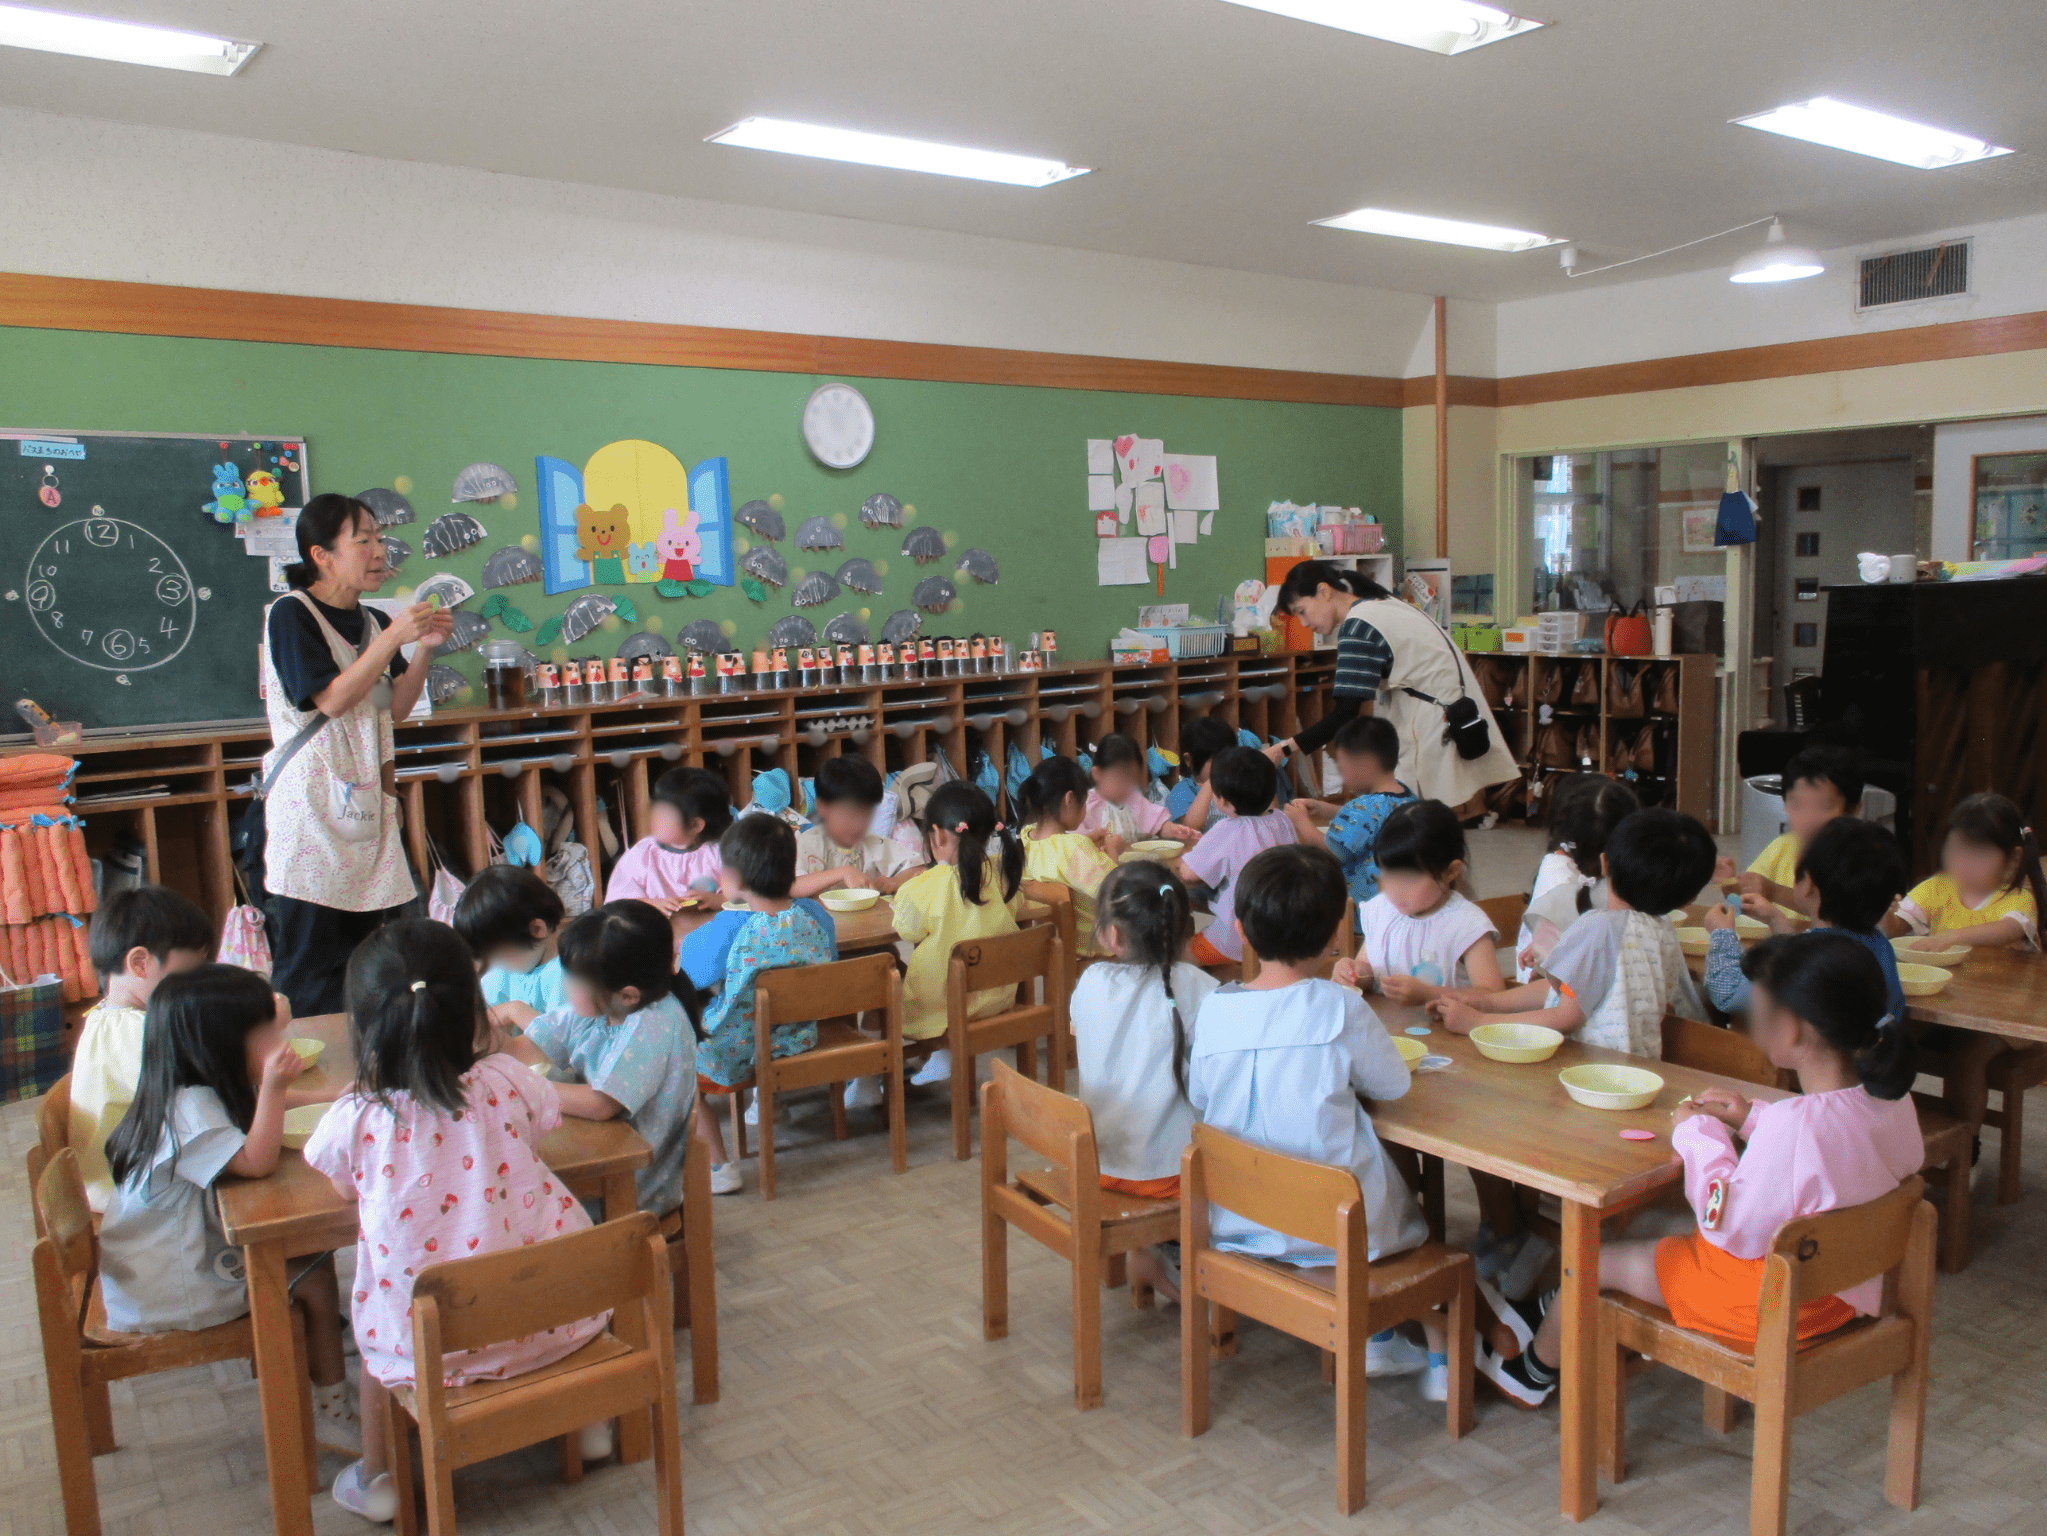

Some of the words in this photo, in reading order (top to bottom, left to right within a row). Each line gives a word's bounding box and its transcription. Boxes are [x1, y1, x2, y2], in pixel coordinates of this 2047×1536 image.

[46, 490, 57, 504] A
[88, 525, 117, 540] 12
[55, 540, 70, 554] 11
[129, 535, 135, 549] 1
[39, 565, 57, 578] 10
[149, 558, 164, 574] 2
[30, 585, 49, 609] 9
[162, 580, 183, 600] 3
[51, 611, 64, 629] 8
[160, 616, 179, 639] 4
[81, 629, 94, 646] 7
[110, 633, 127, 656] 6
[138, 637, 150, 654] 5
[337, 805, 375, 821] Jackie
